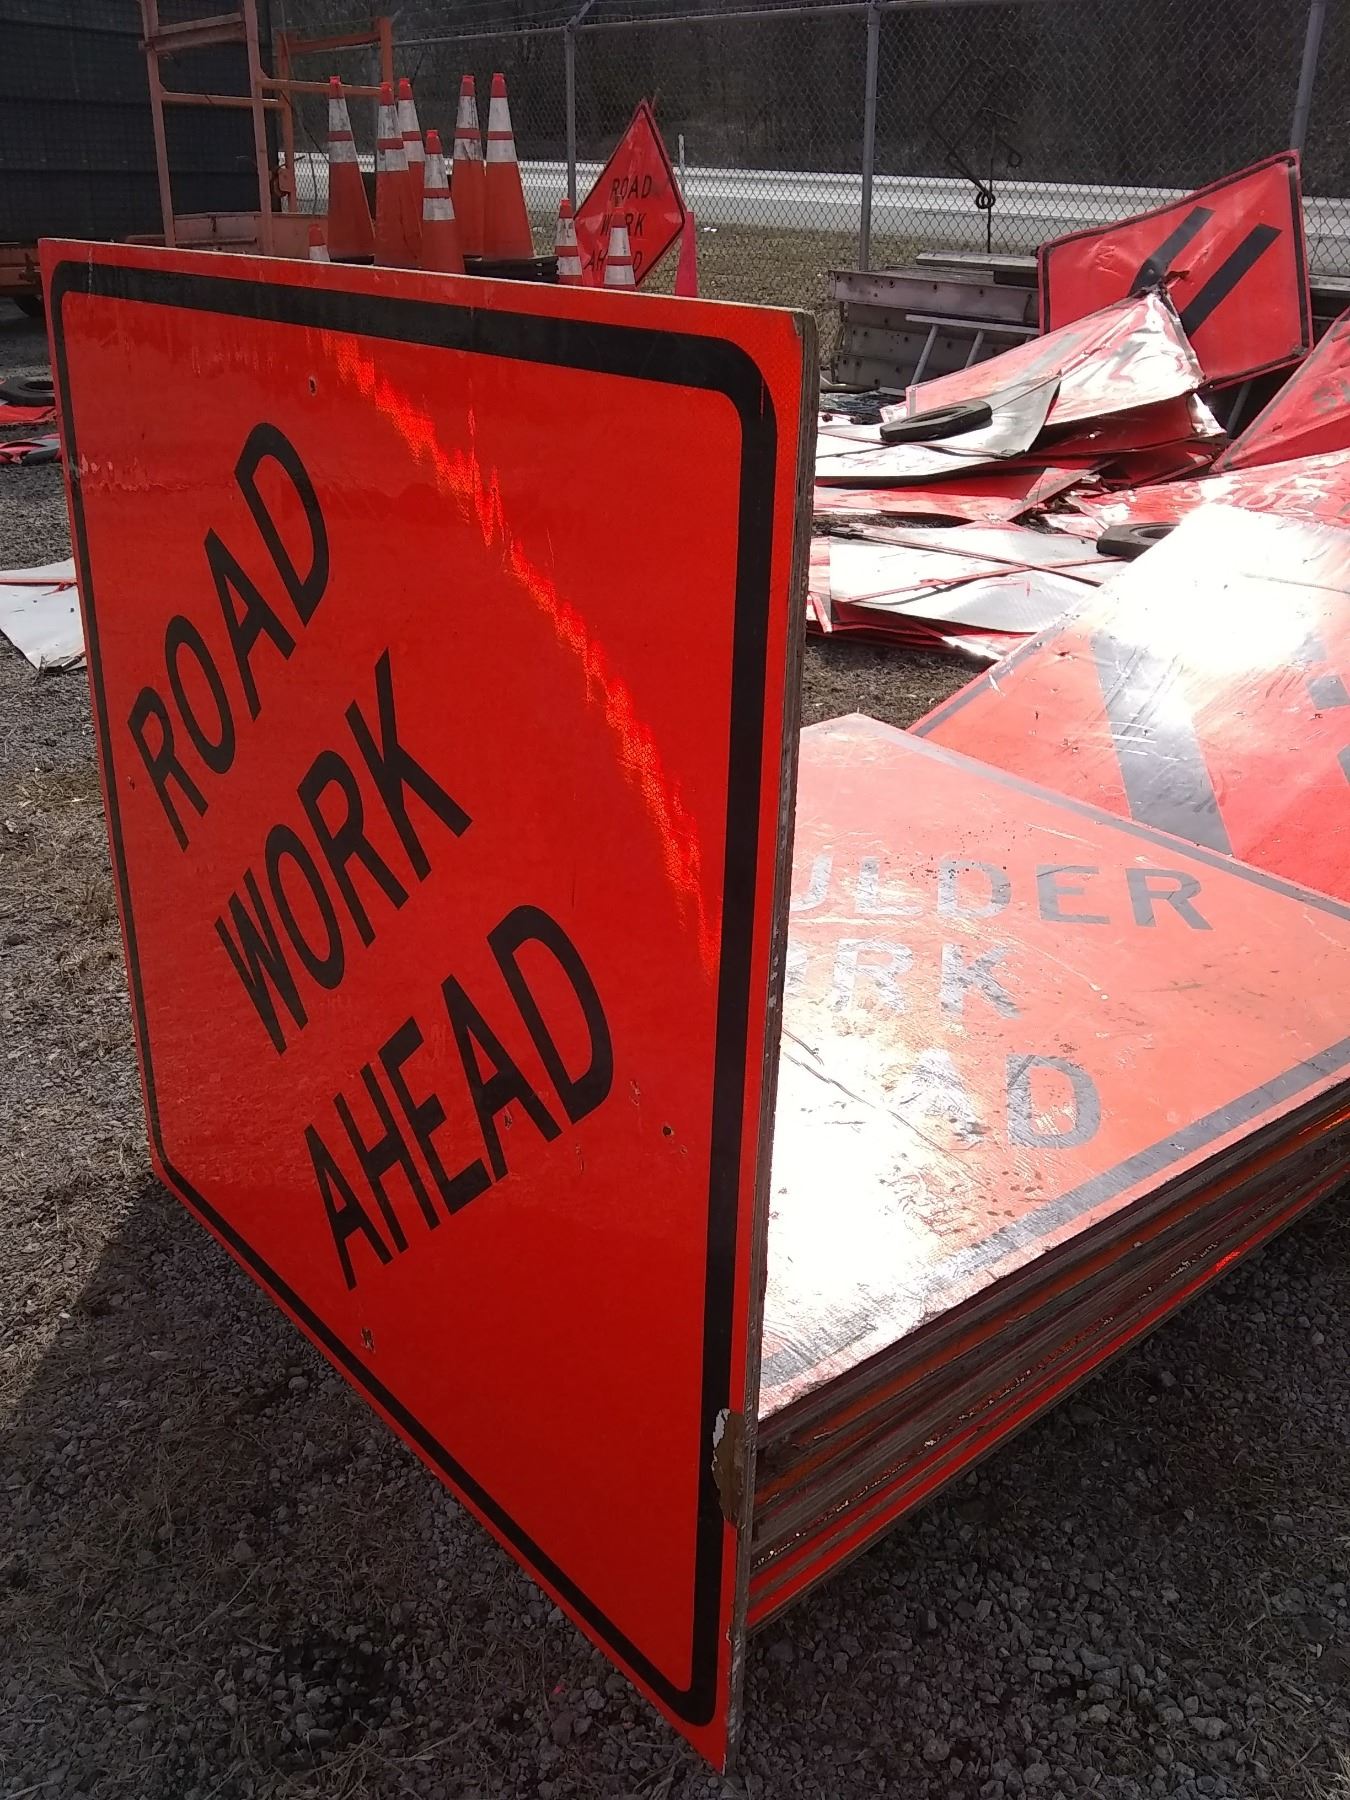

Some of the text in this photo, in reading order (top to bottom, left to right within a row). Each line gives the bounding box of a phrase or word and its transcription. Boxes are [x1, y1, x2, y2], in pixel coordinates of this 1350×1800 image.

[584, 249, 643, 275] AHD
[600, 213, 646, 236] WRK
[611, 175, 652, 200] ROAD
[128, 422, 330, 852] ROAD
[213, 647, 472, 1054] WORK
[303, 904, 614, 1290] AHEAD
